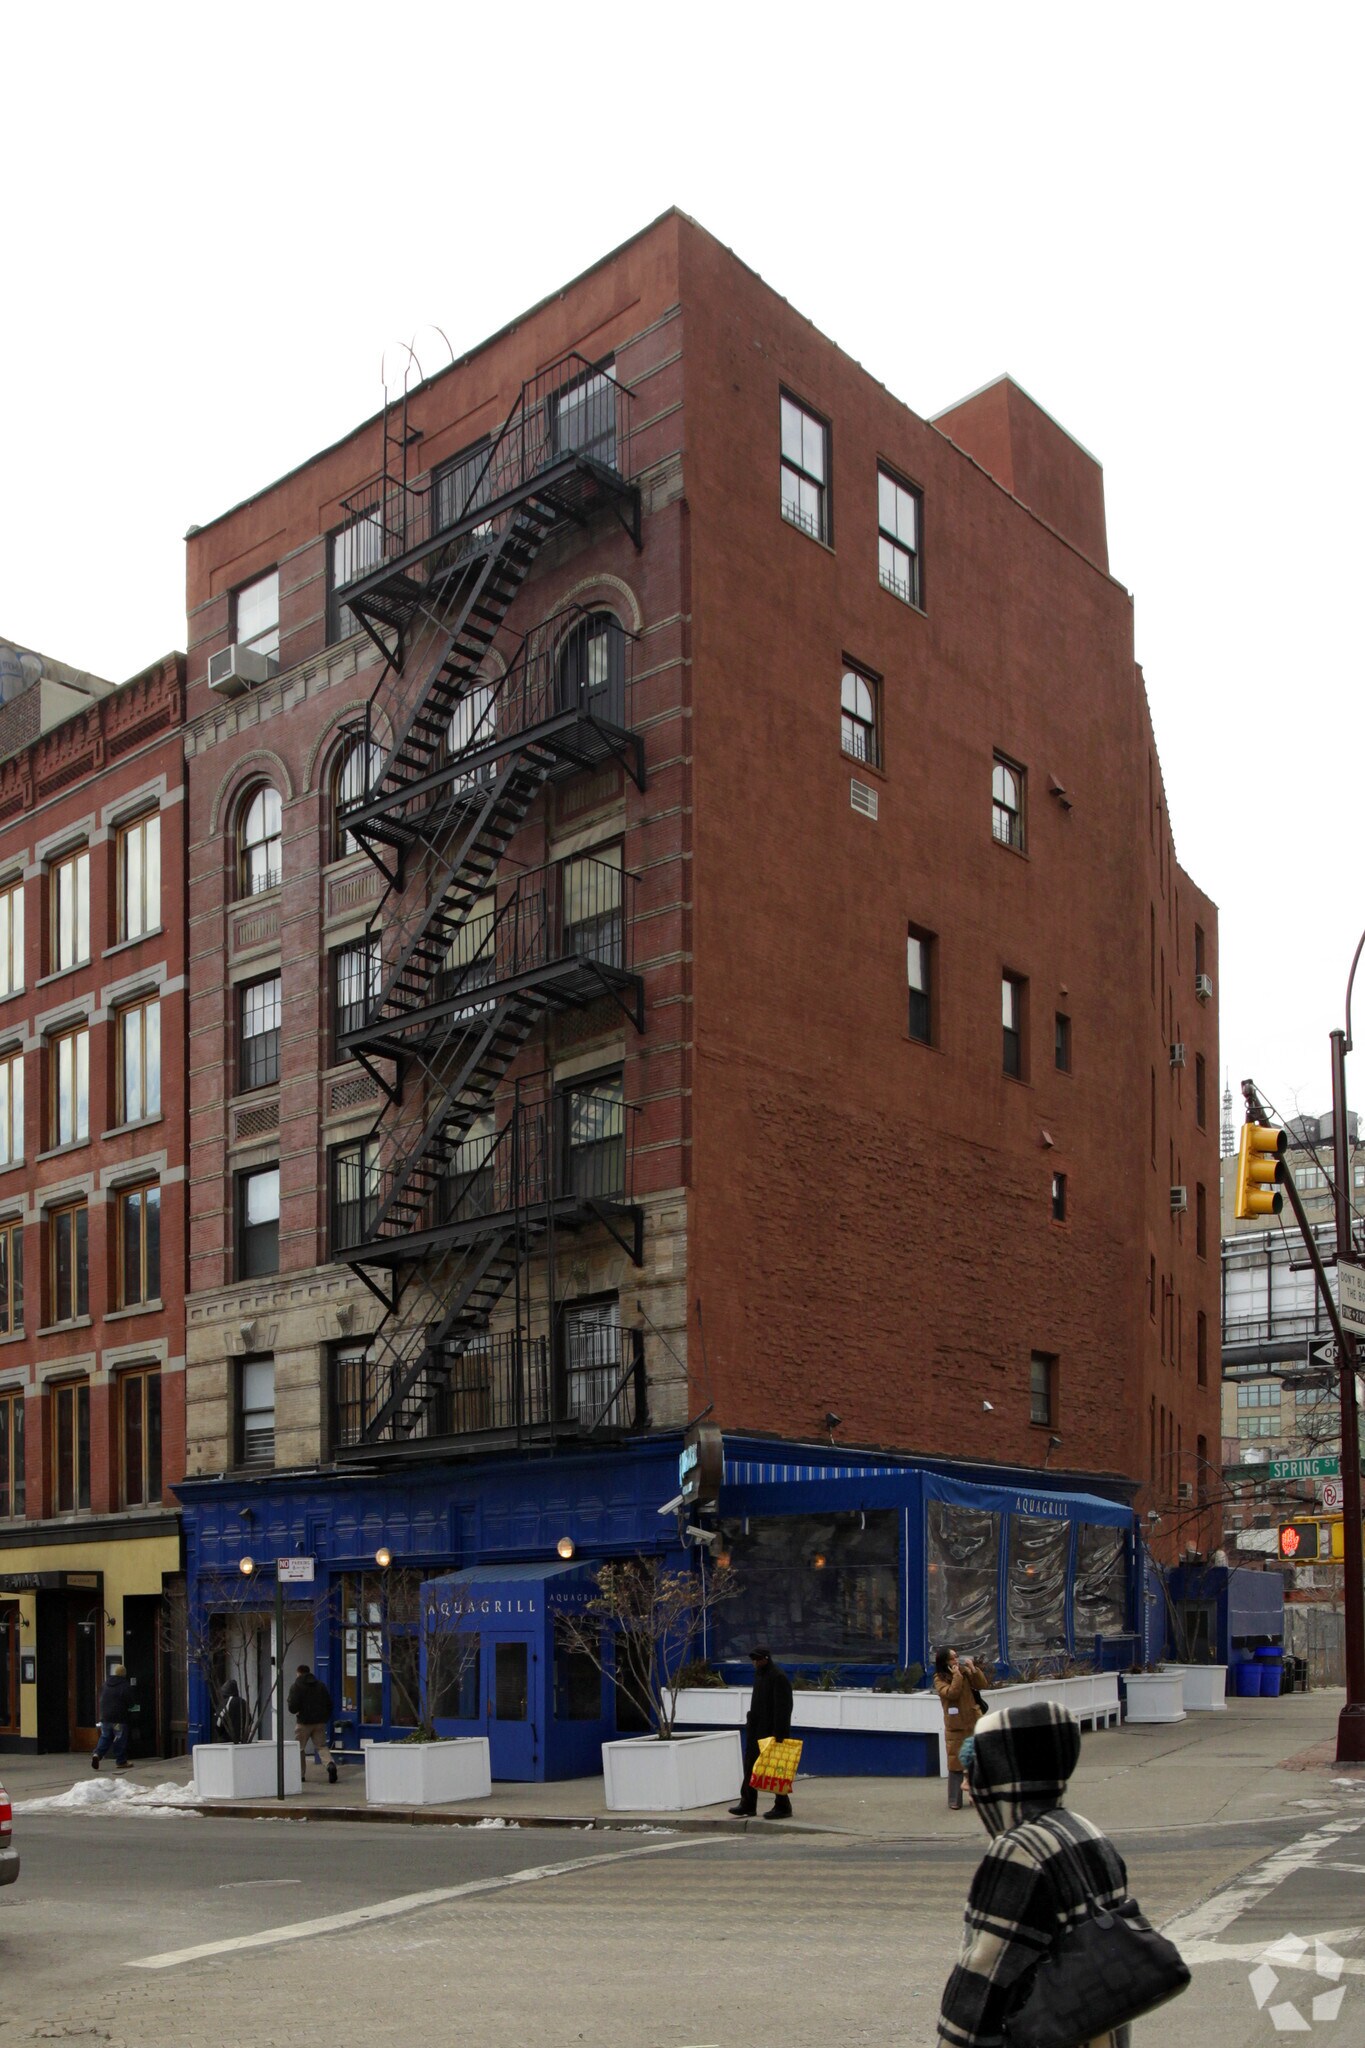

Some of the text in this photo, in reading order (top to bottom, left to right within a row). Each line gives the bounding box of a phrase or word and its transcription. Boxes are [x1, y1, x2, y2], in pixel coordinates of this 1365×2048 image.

[1273, 1458, 1336, 1478] SPRING ST
[1015, 1496, 1068, 1516] AQUAGRILL
[279, 1560, 289, 1568] NO
[428, 1600, 536, 1617] AQUAGRILL
